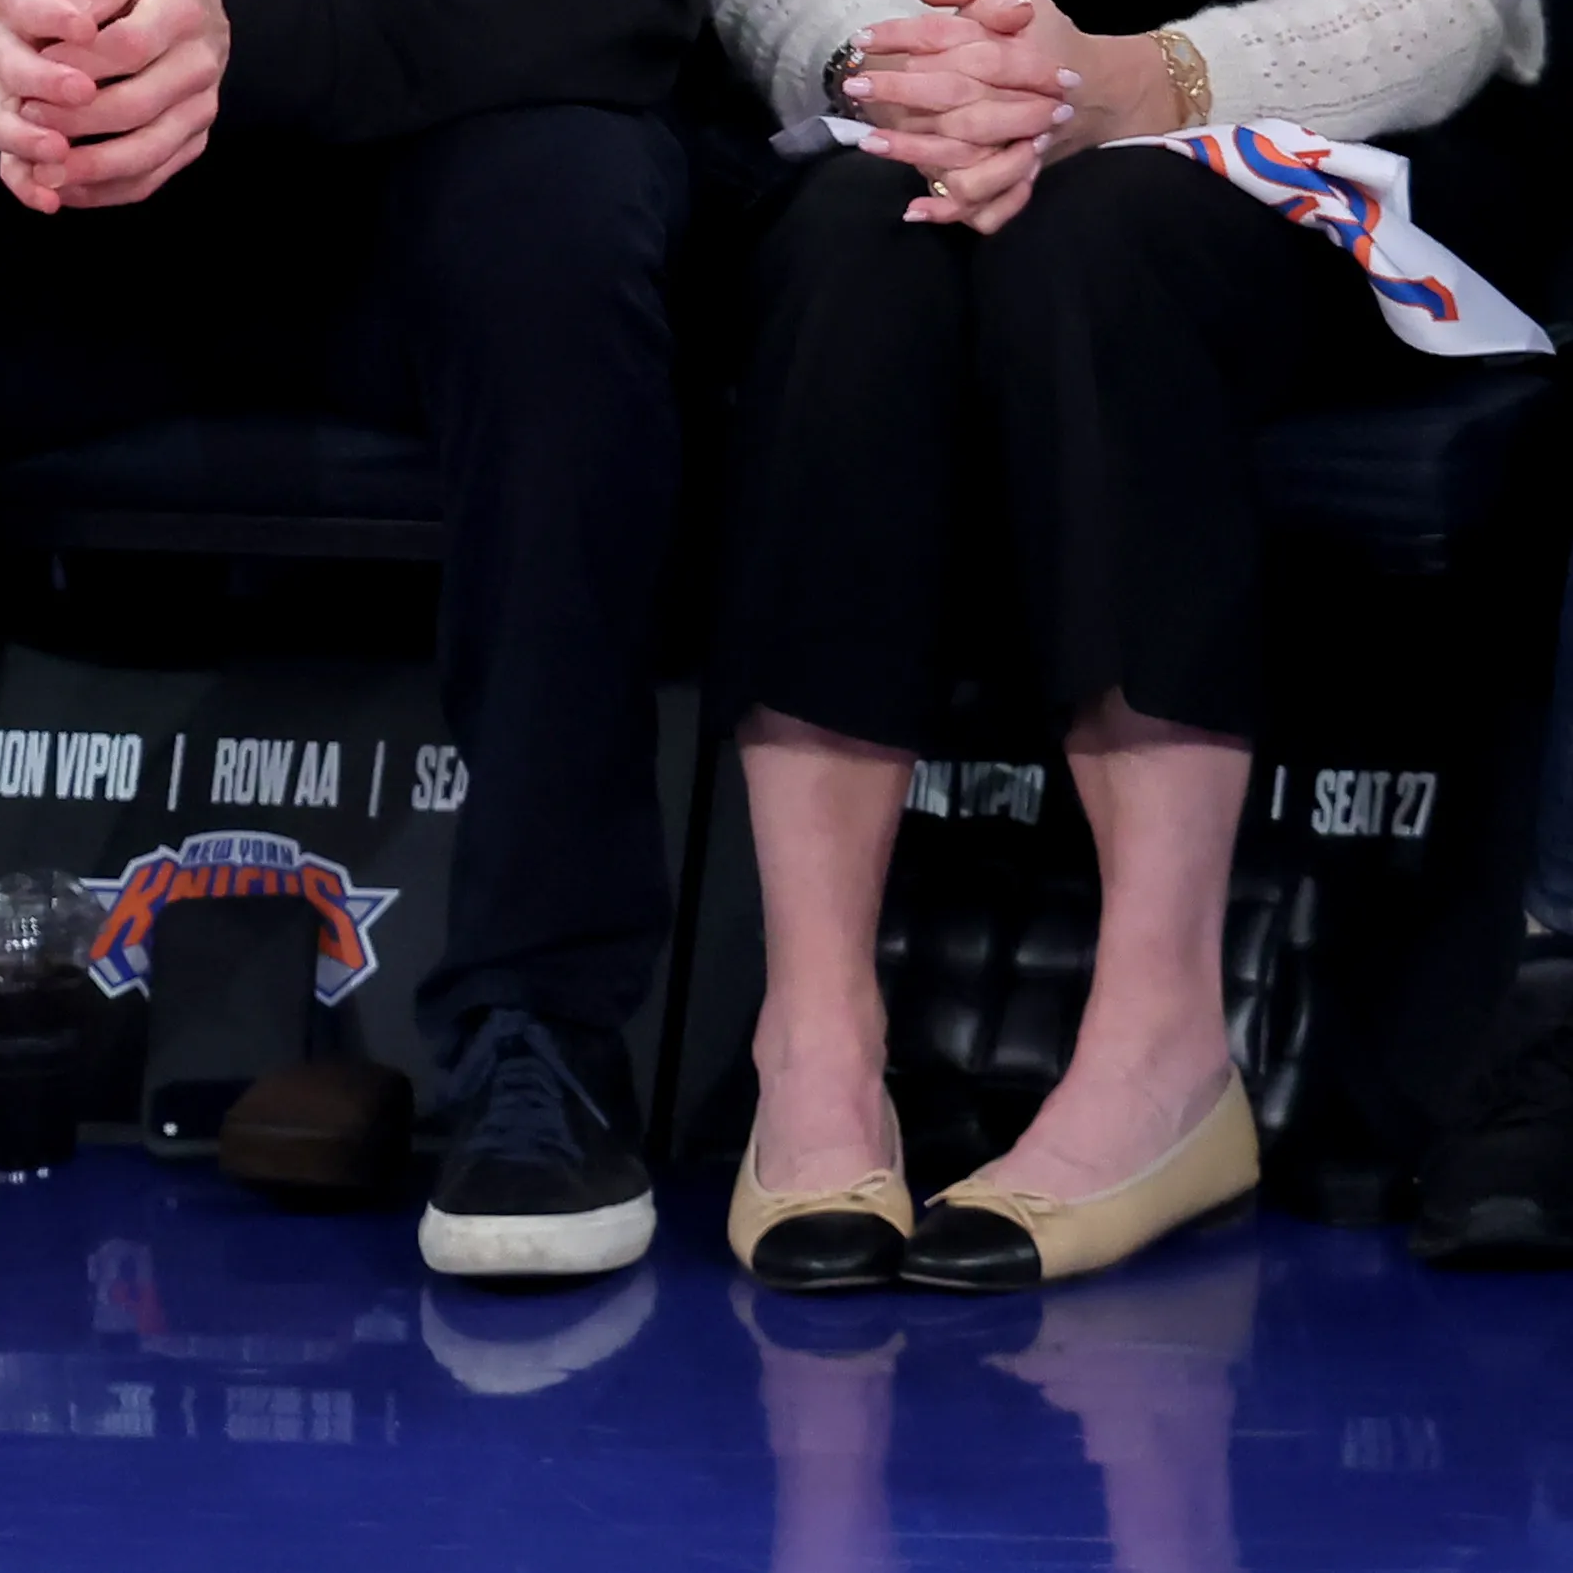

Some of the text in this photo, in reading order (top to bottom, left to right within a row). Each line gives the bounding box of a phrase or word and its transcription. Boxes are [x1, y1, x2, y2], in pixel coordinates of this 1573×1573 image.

[210, 736, 296, 807] ROW
[293, 740, 341, 808] AA
[410, 743, 470, 813] SEA
[1309, 767, 1394, 839] SEAT
[1390, 769, 1440, 840] 27
